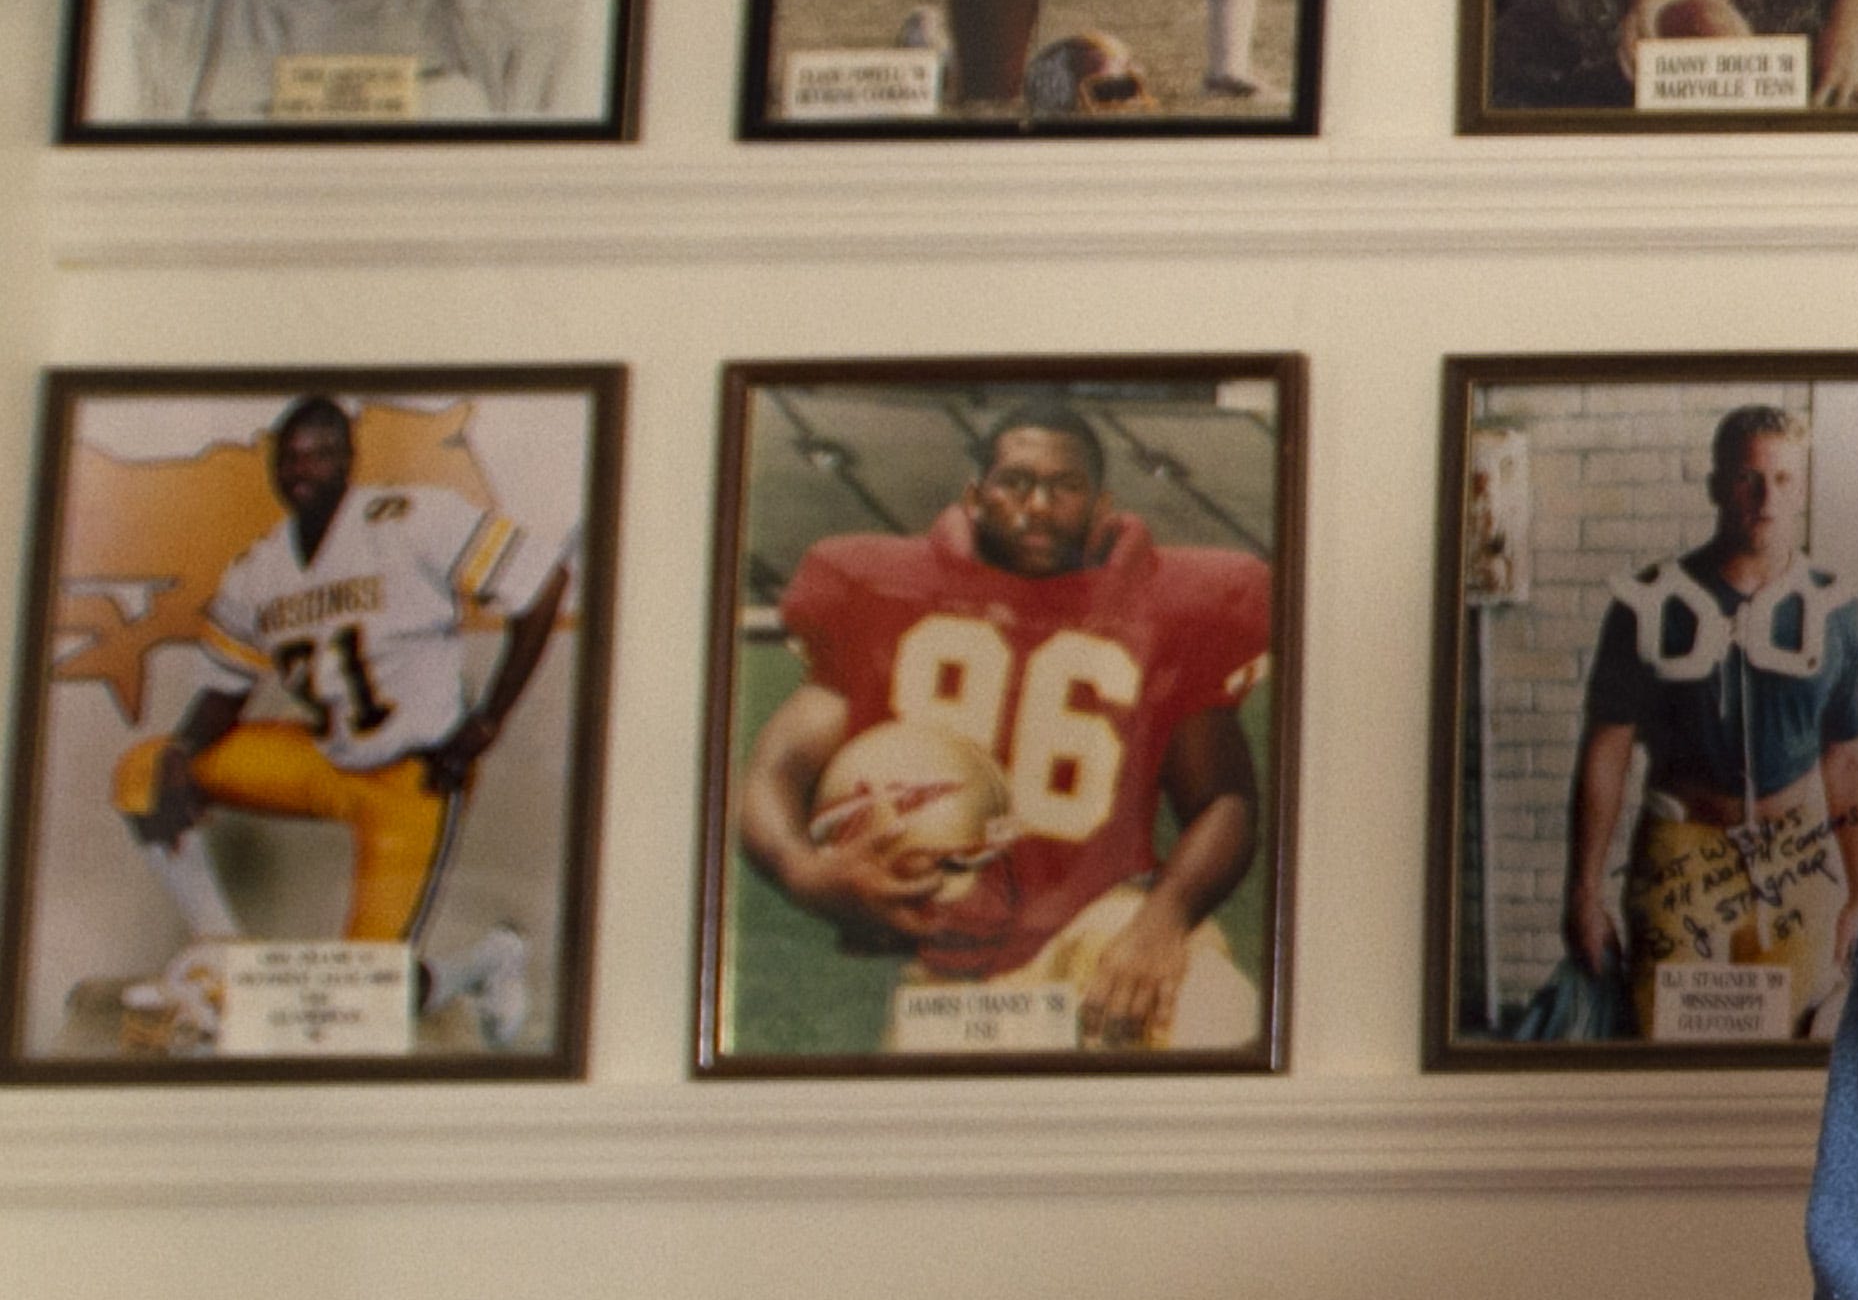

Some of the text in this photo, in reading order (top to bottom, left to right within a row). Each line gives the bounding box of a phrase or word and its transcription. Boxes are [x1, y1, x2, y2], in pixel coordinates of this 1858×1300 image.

[1656, 55, 1707, 76] DANNY
[1654, 78, 1745, 99] MARYVILLE
[889, 611, 1143, 845] 86
[906, 994, 961, 1016] JAMES
